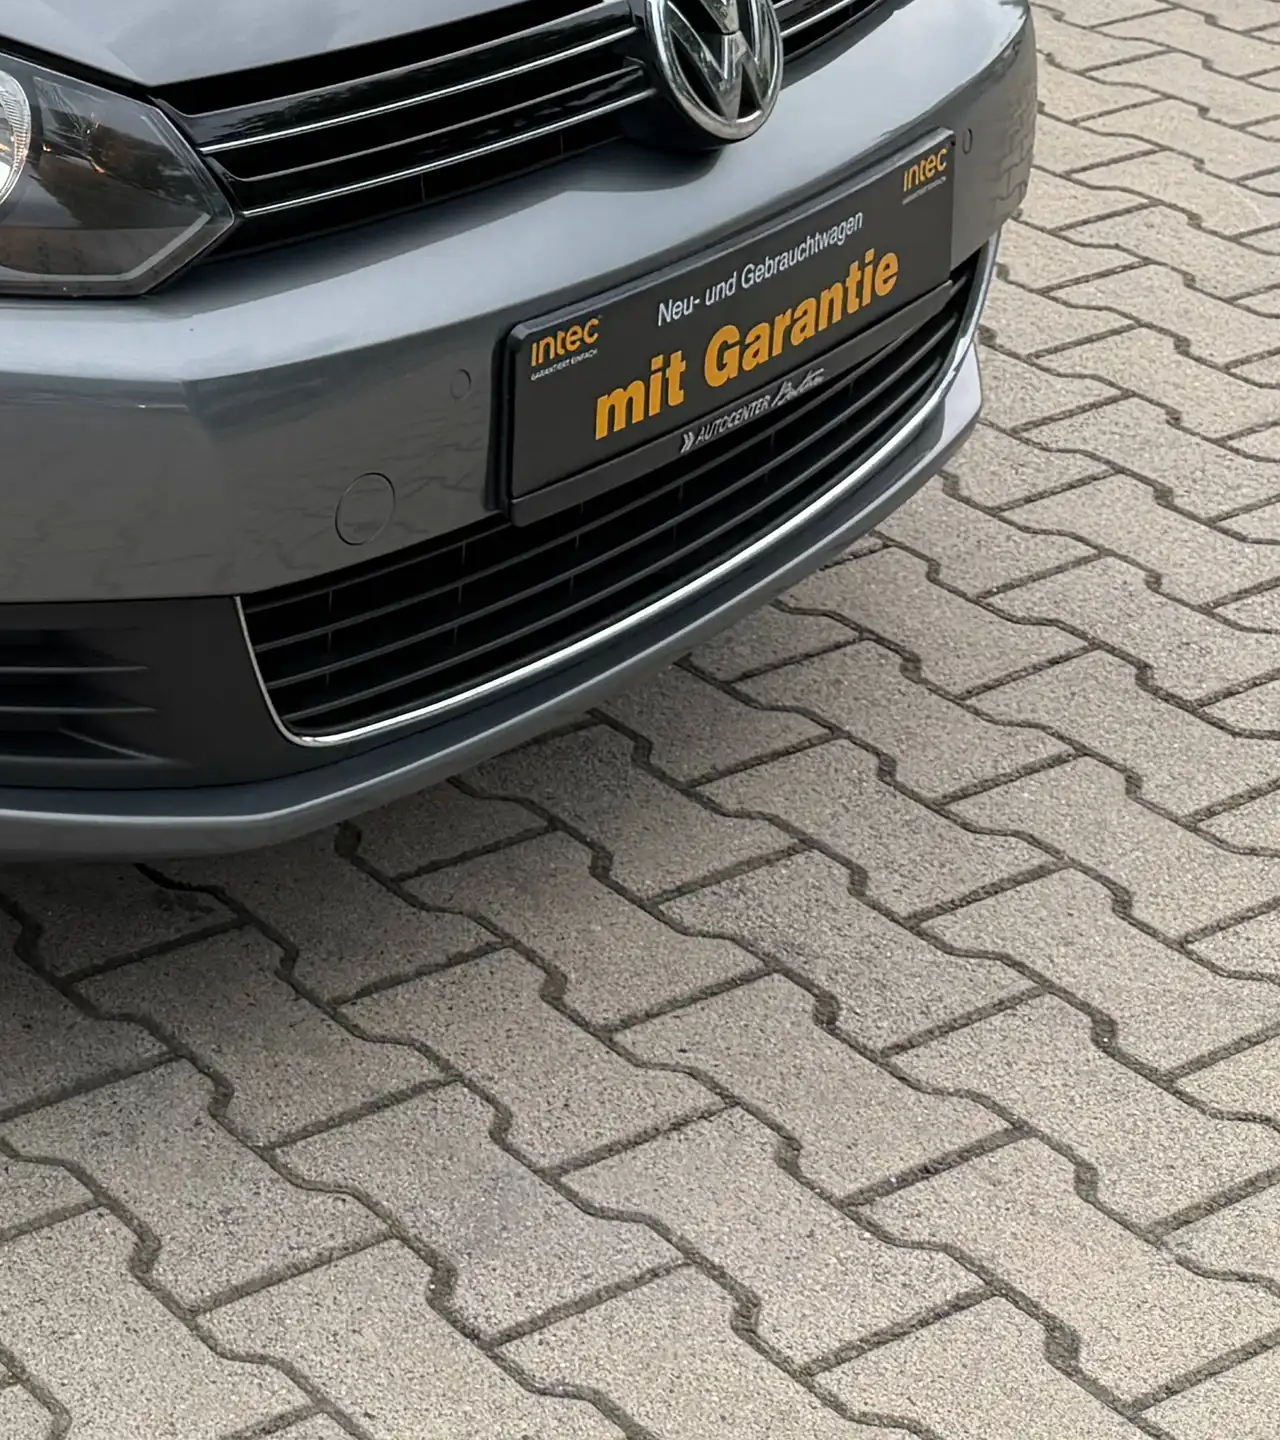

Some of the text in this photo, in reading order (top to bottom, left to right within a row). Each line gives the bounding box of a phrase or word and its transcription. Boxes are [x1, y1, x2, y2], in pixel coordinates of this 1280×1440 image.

[902, 148, 948, 193] intec
[657, 211, 864, 327] Neu- und Gebrauchtwagen
[530, 317, 601, 367] intec
[595, 248, 900, 441] mit Garantie
[695, 394, 771, 446] AUTOCENTER
